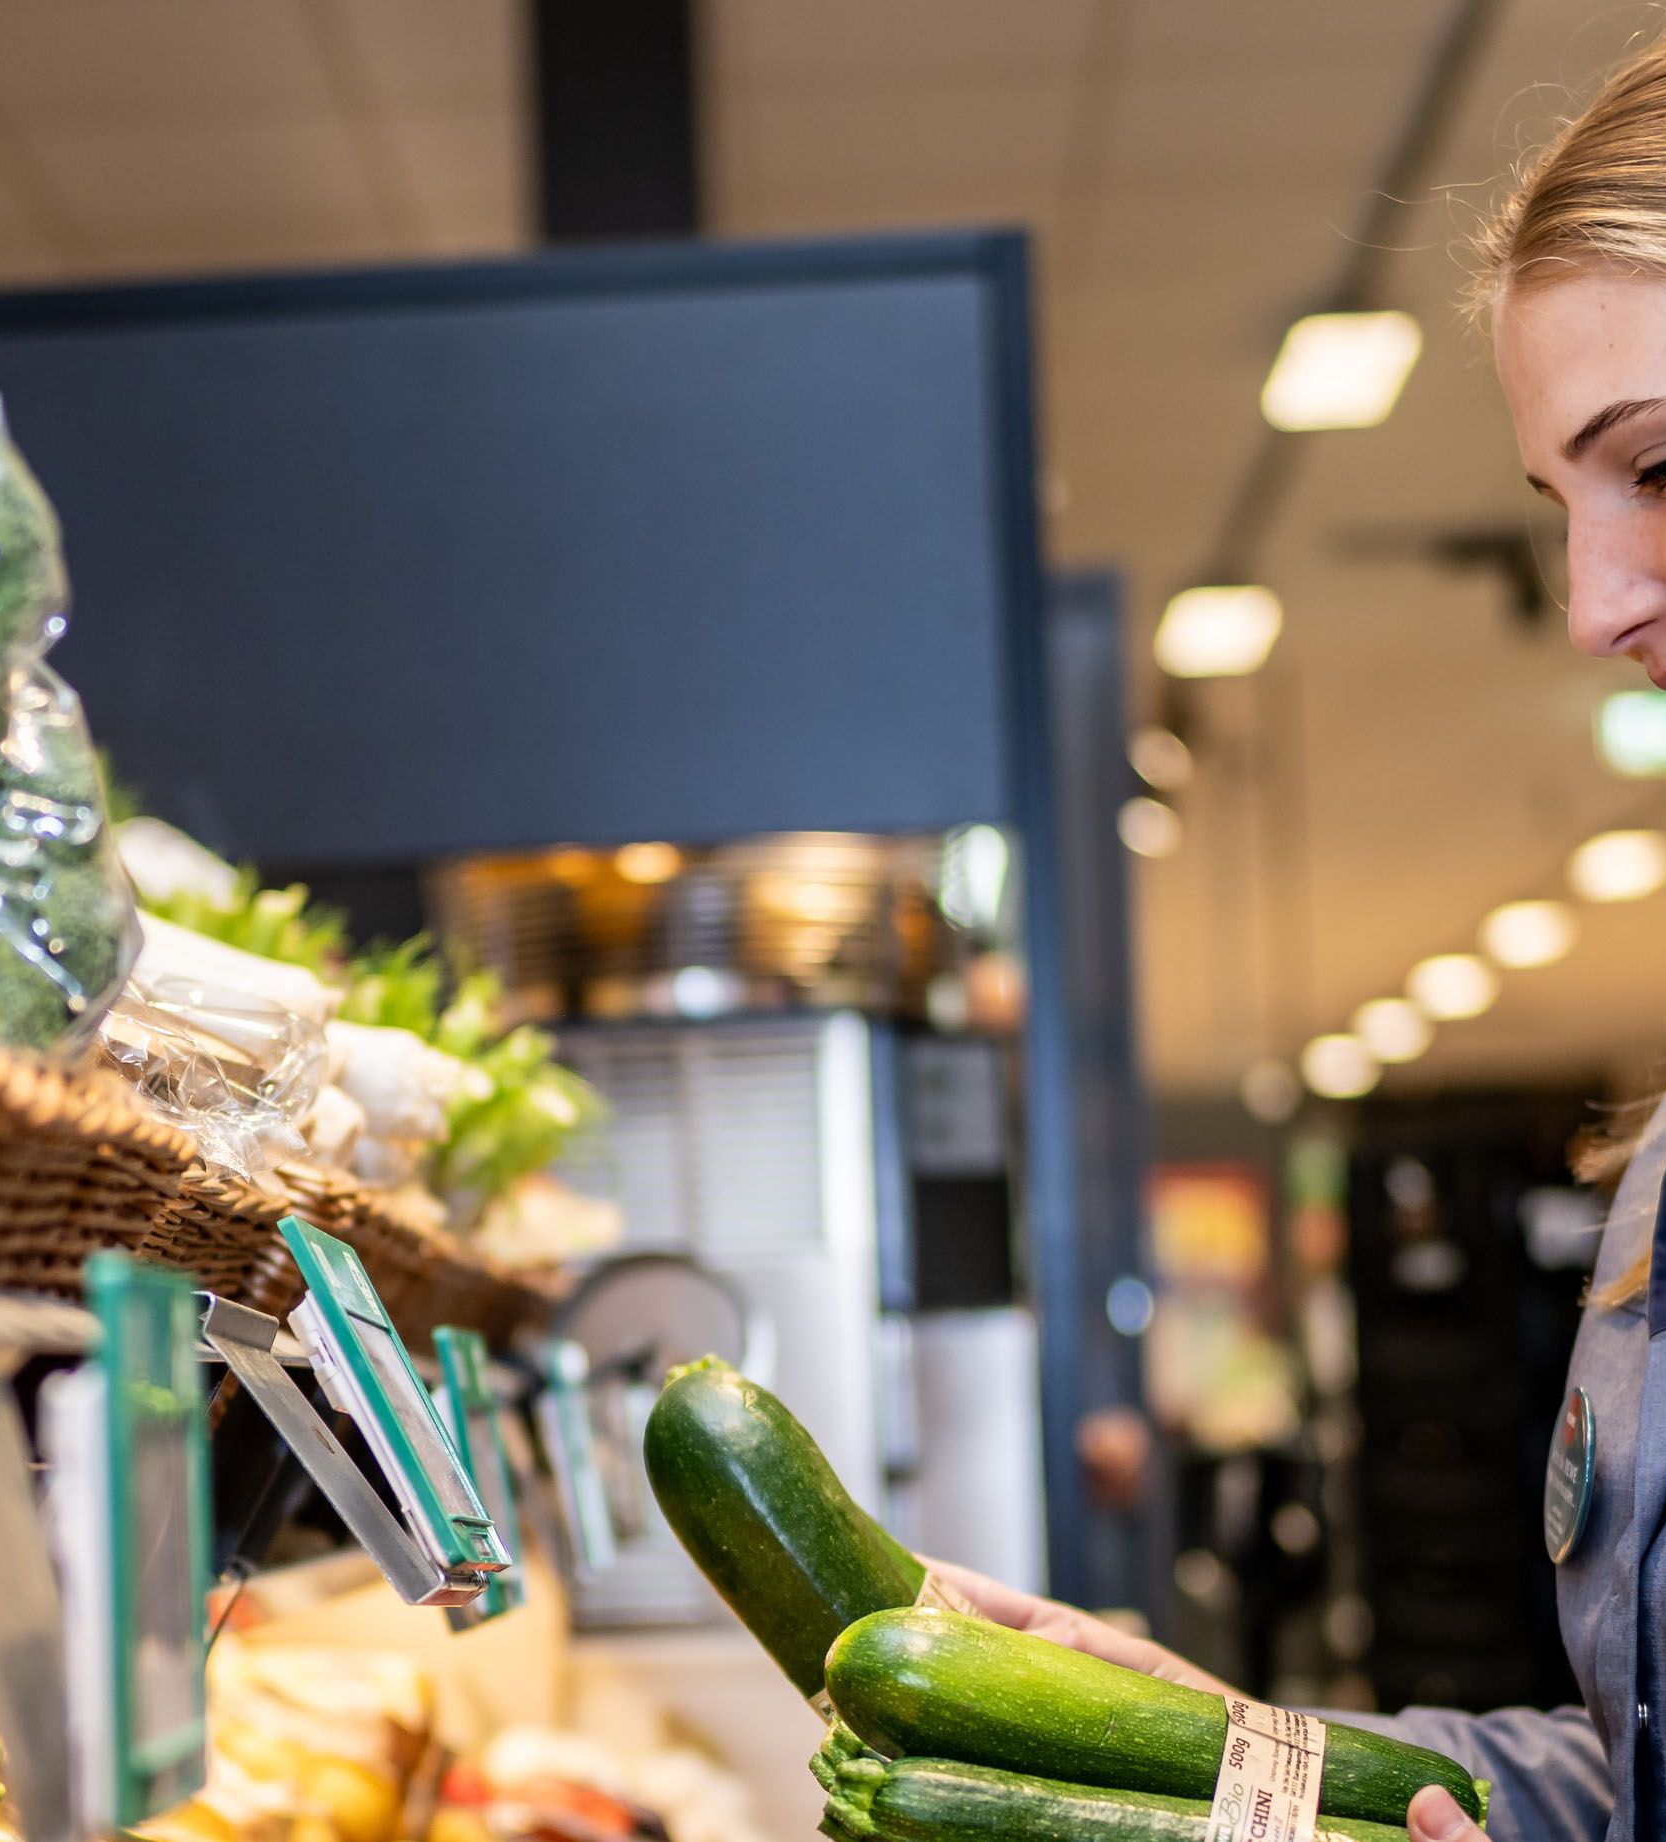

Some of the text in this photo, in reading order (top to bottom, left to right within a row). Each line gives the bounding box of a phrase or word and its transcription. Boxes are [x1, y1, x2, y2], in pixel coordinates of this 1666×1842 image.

[1232, 1700, 1249, 1725] 500g
[1229, 1737, 1251, 1771] 500g
[1218, 1783, 1244, 1826] Bio
